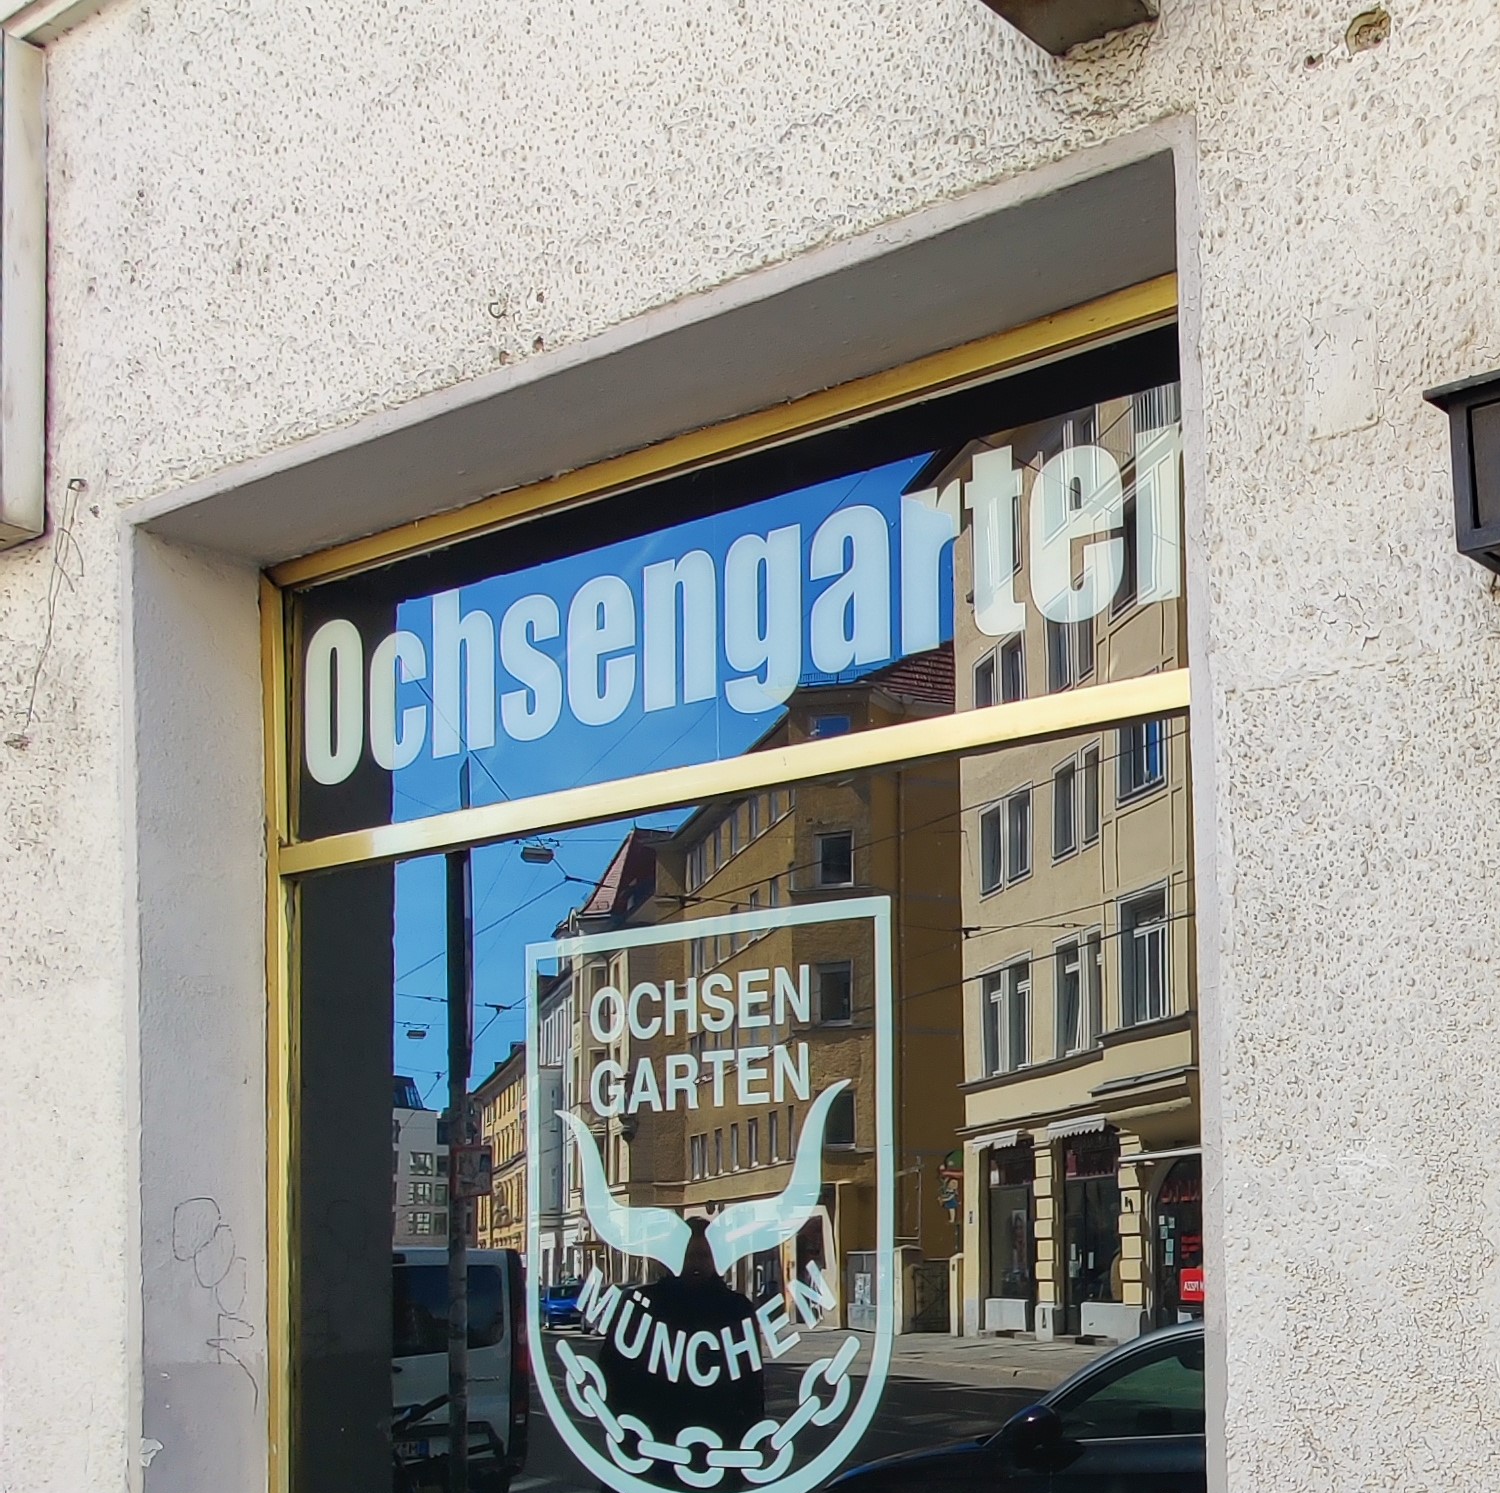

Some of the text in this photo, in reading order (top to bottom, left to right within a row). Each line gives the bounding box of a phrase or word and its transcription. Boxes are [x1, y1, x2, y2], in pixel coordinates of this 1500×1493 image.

[589, 964, 811, 1044] OCHSEN
[590, 1041, 811, 1118] GARTEN
[576, 1259, 837, 1387] MÜNCHEN
